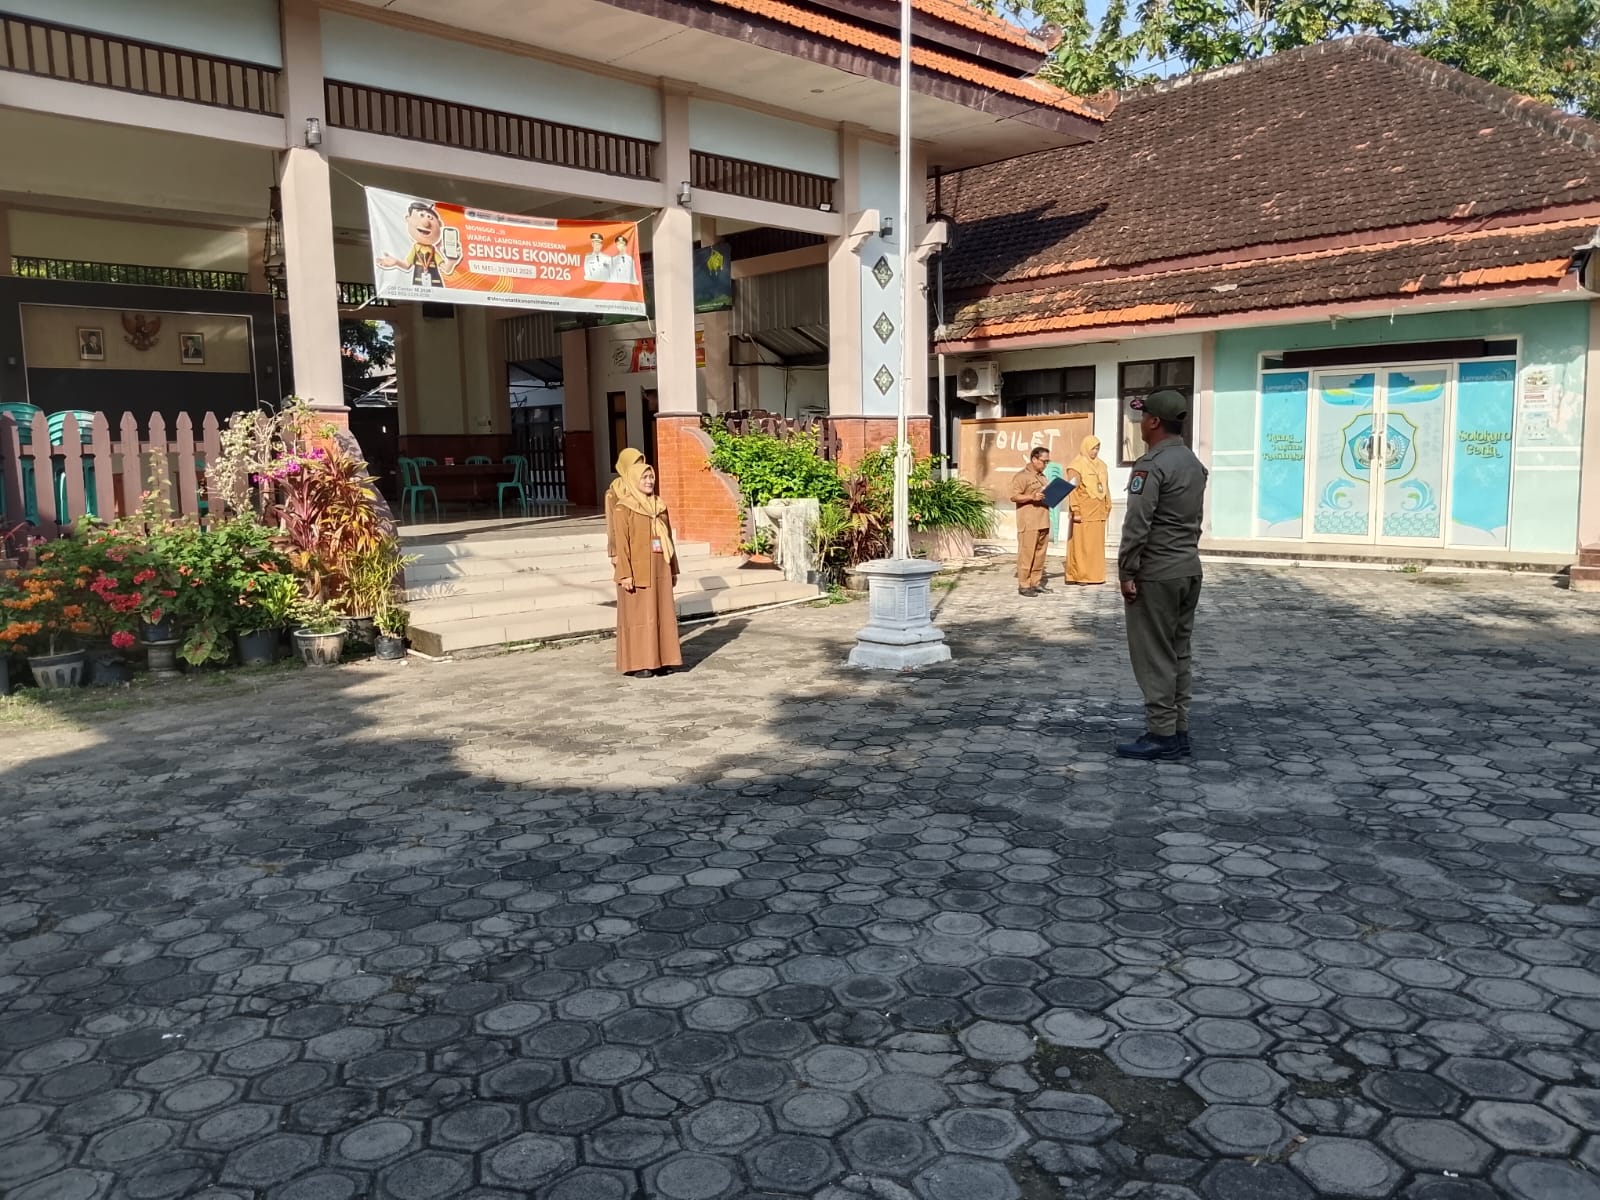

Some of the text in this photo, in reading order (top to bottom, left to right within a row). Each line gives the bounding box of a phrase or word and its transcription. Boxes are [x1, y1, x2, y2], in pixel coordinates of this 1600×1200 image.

[467, 233, 567, 250] WARGA LAMONGAN SUKSESKAN
[468, 243, 581, 267] SENSUS EKONOMI
[539, 265, 571, 281] 2026
[976, 428, 1060, 452] TOILET
